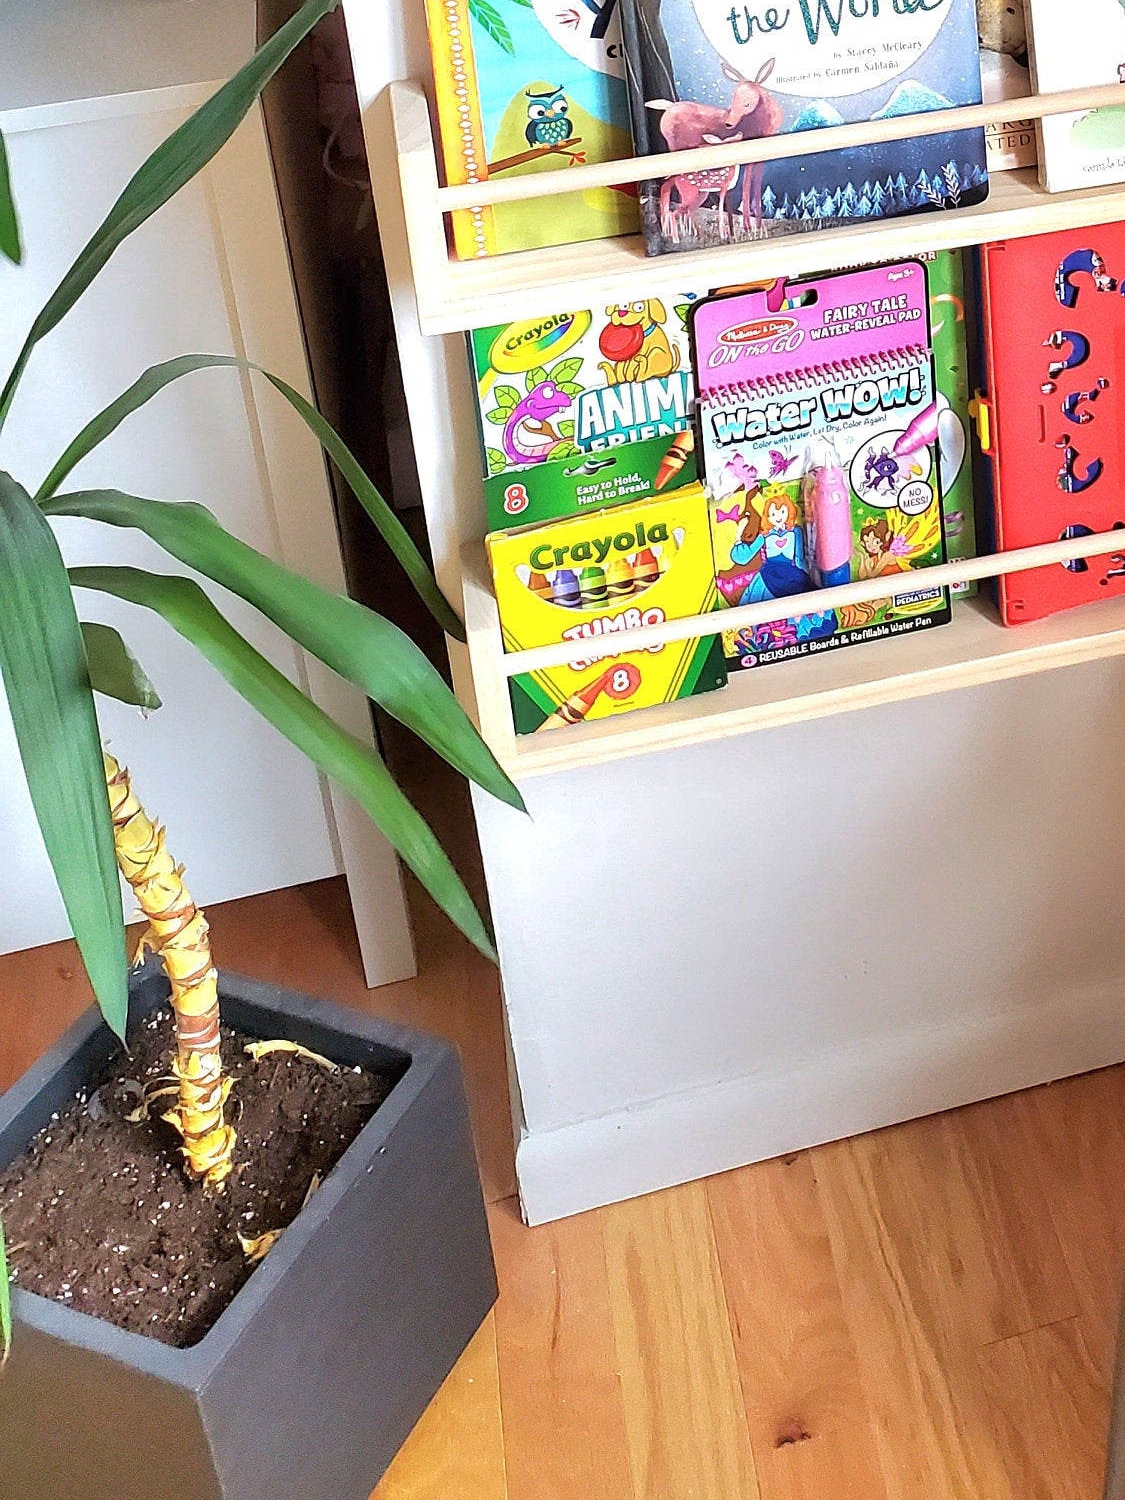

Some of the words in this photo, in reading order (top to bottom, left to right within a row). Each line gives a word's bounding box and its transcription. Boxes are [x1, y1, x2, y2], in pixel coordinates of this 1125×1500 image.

[726, 5, 791, 45] the
[847, 47, 877, 59] Stacey
[881, 40, 923, 54] McCleary
[776, 72, 811, 84] Illustrated
[825, 66, 860, 78] Carmen
[864, 60, 900, 72] Saldaña
[886, 272, 903, 283] Ages
[823, 302, 869, 324] FAIRY
[871, 294, 907, 315] TALE
[505, 312, 570, 351] Crayola
[810, 313, 896, 341] WATER-REVEAL
[898, 308, 922, 323] PAD
[708, 345, 744, 369] ON
[744, 343, 768, 357] the
[771, 330, 805, 352] GO
[711, 396, 817, 447] Water
[820, 367, 924, 422] WOW!
[752, 438, 772, 450] Color
[773, 436, 789, 447] with
[789, 431, 812, 444] Water,
[826, 422, 842, 436] Dry,
[843, 419, 862, 431] Color
[863, 414, 887, 428] Again!
[503, 484, 529, 515] 8
[576, 485, 599, 498] Easy
[600, 480, 612, 489] to
[614, 473, 641, 486] Hold,
[577, 491, 603, 506] Hard
[604, 489, 617, 499] to
[618, 480, 650, 496] Break!
[909, 488, 922, 498] NO
[903, 496, 929, 509] MESS!
[529, 521, 670, 571] Crayola
[896, 590, 940, 606] PEDIATRICS
[759, 644, 808, 663] REUSABLE
[809, 638, 840, 651] Boards
[840, 635, 849, 645] &
[851, 626, 889, 642] Refillable
[889, 621, 914, 634] Water
[915, 616, 932, 628] Pen
[612, 669, 630, 692] 8
